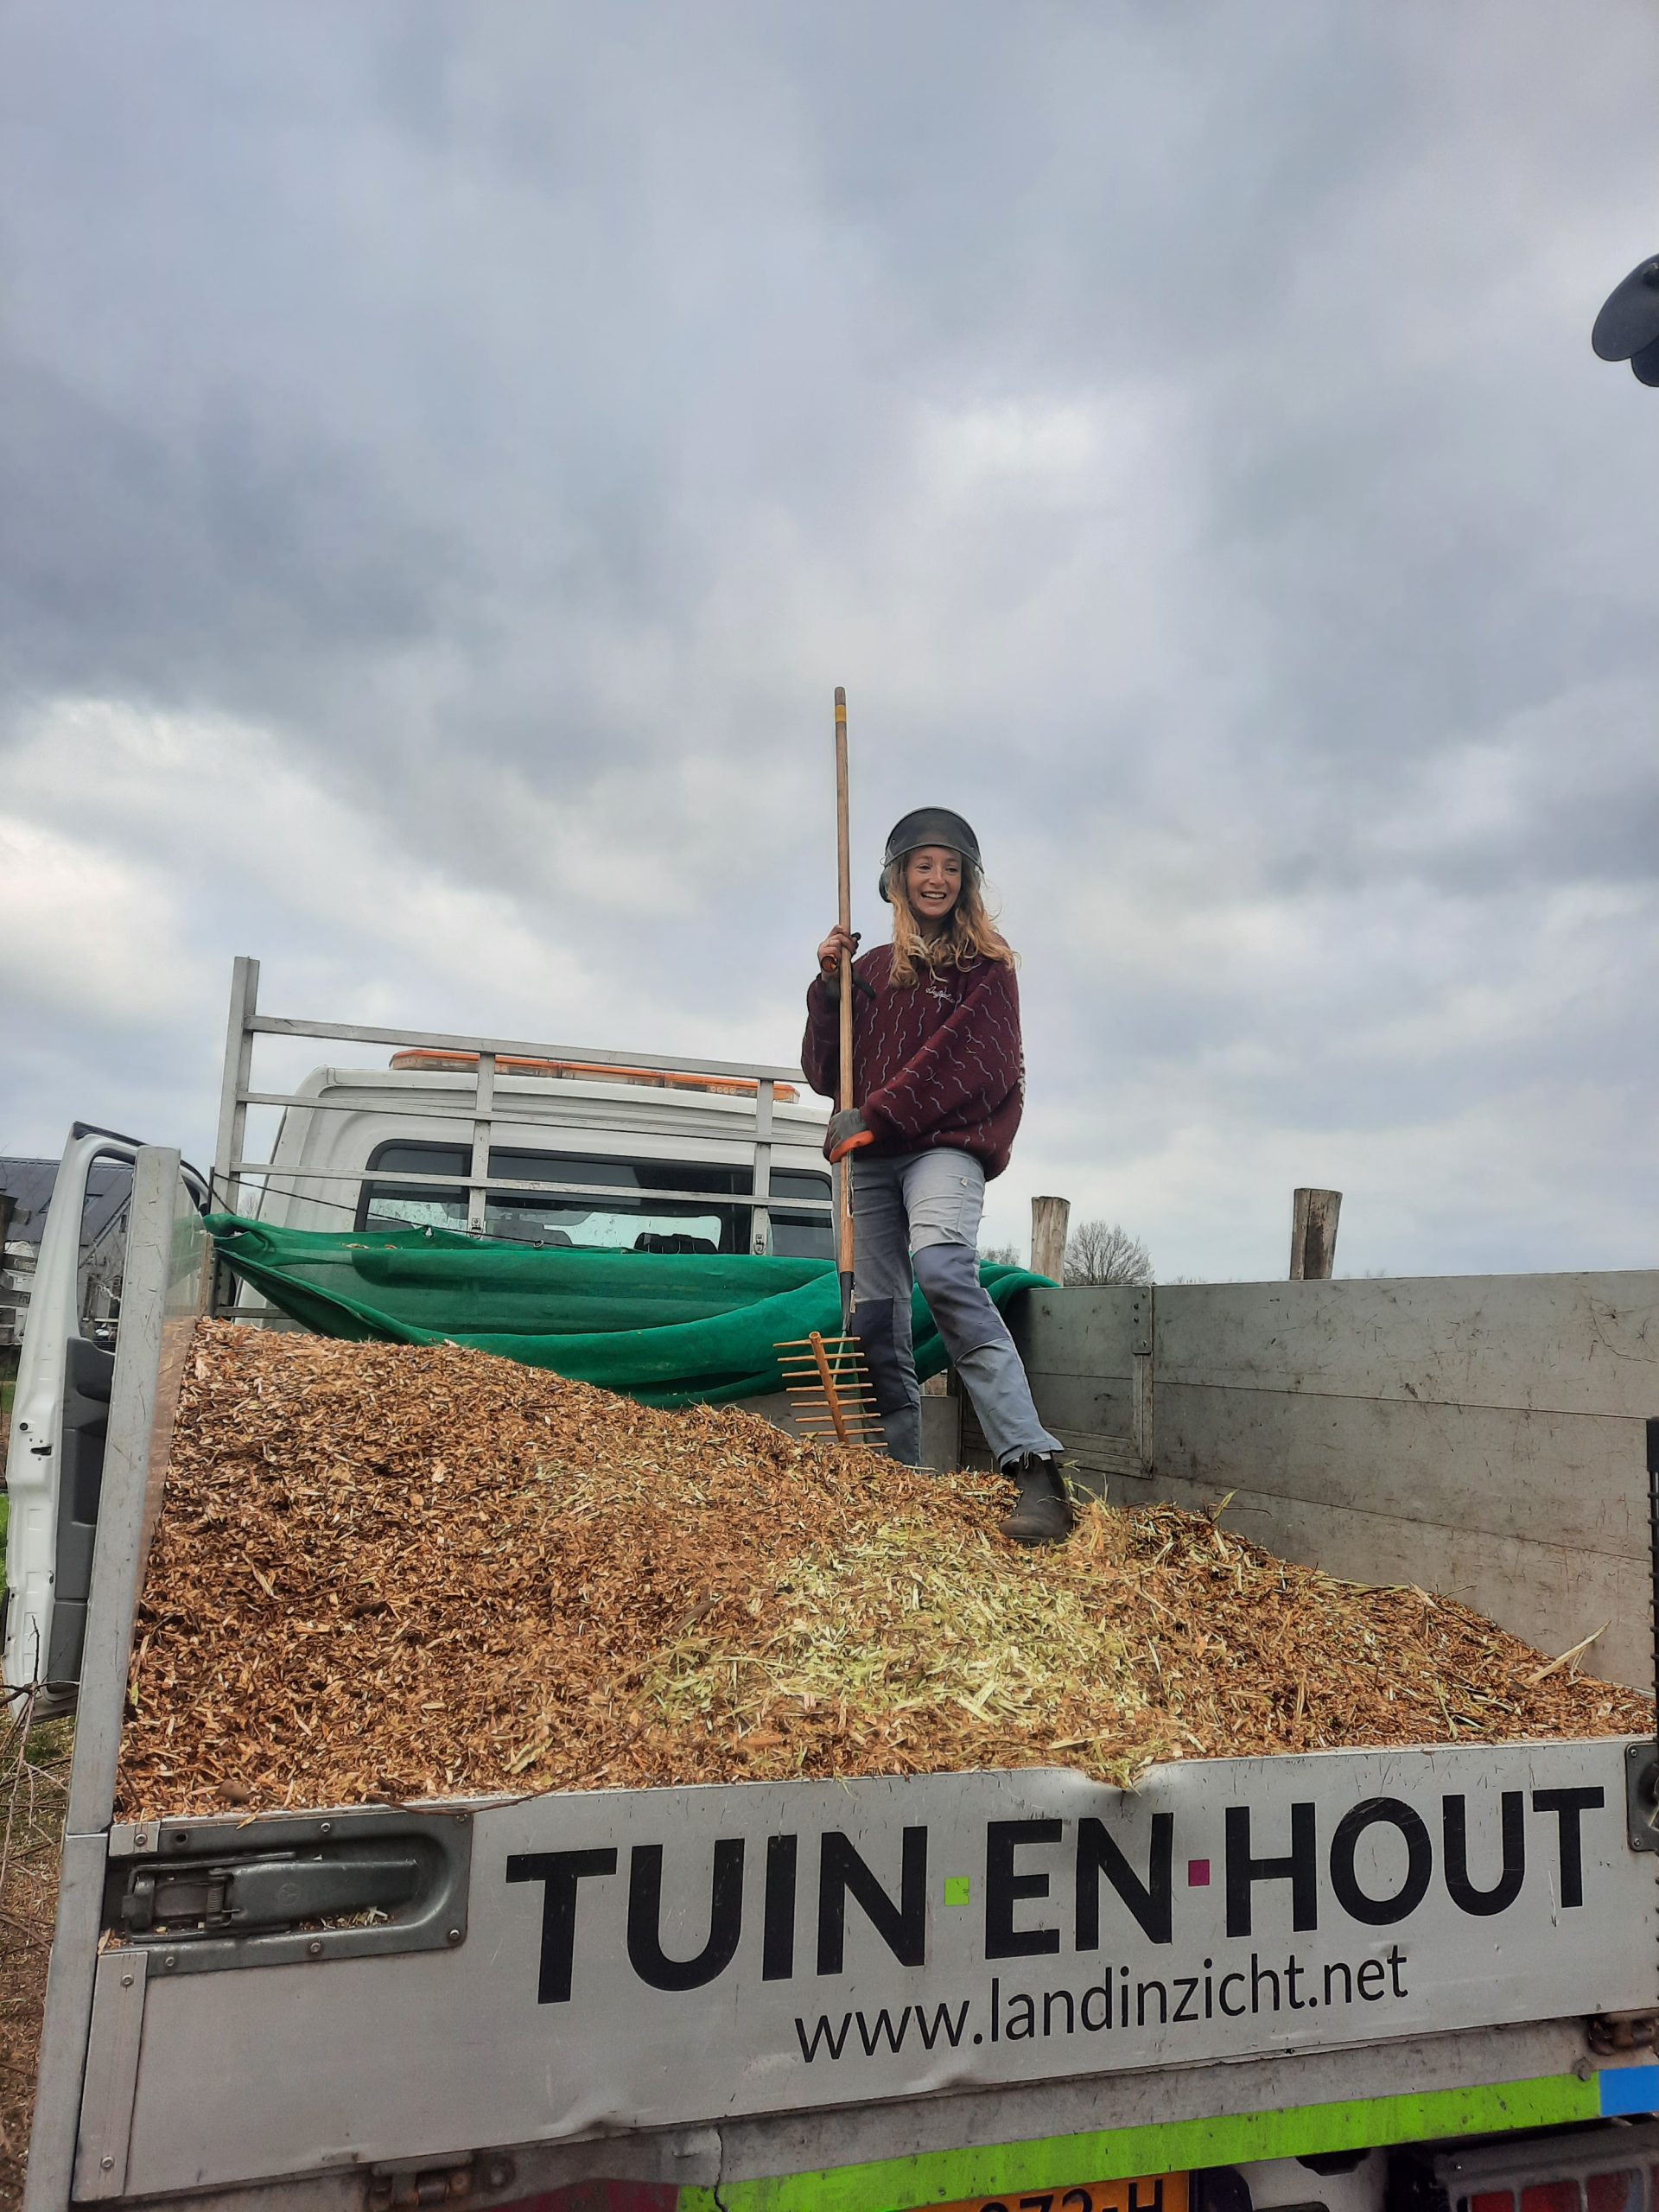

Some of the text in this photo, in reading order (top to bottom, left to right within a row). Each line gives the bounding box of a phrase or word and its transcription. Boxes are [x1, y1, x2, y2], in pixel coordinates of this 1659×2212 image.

[505, 1786, 1605, 2005] TUIN EN HOUT
[794, 1945, 1408, 2063] www.landinzicht.net
